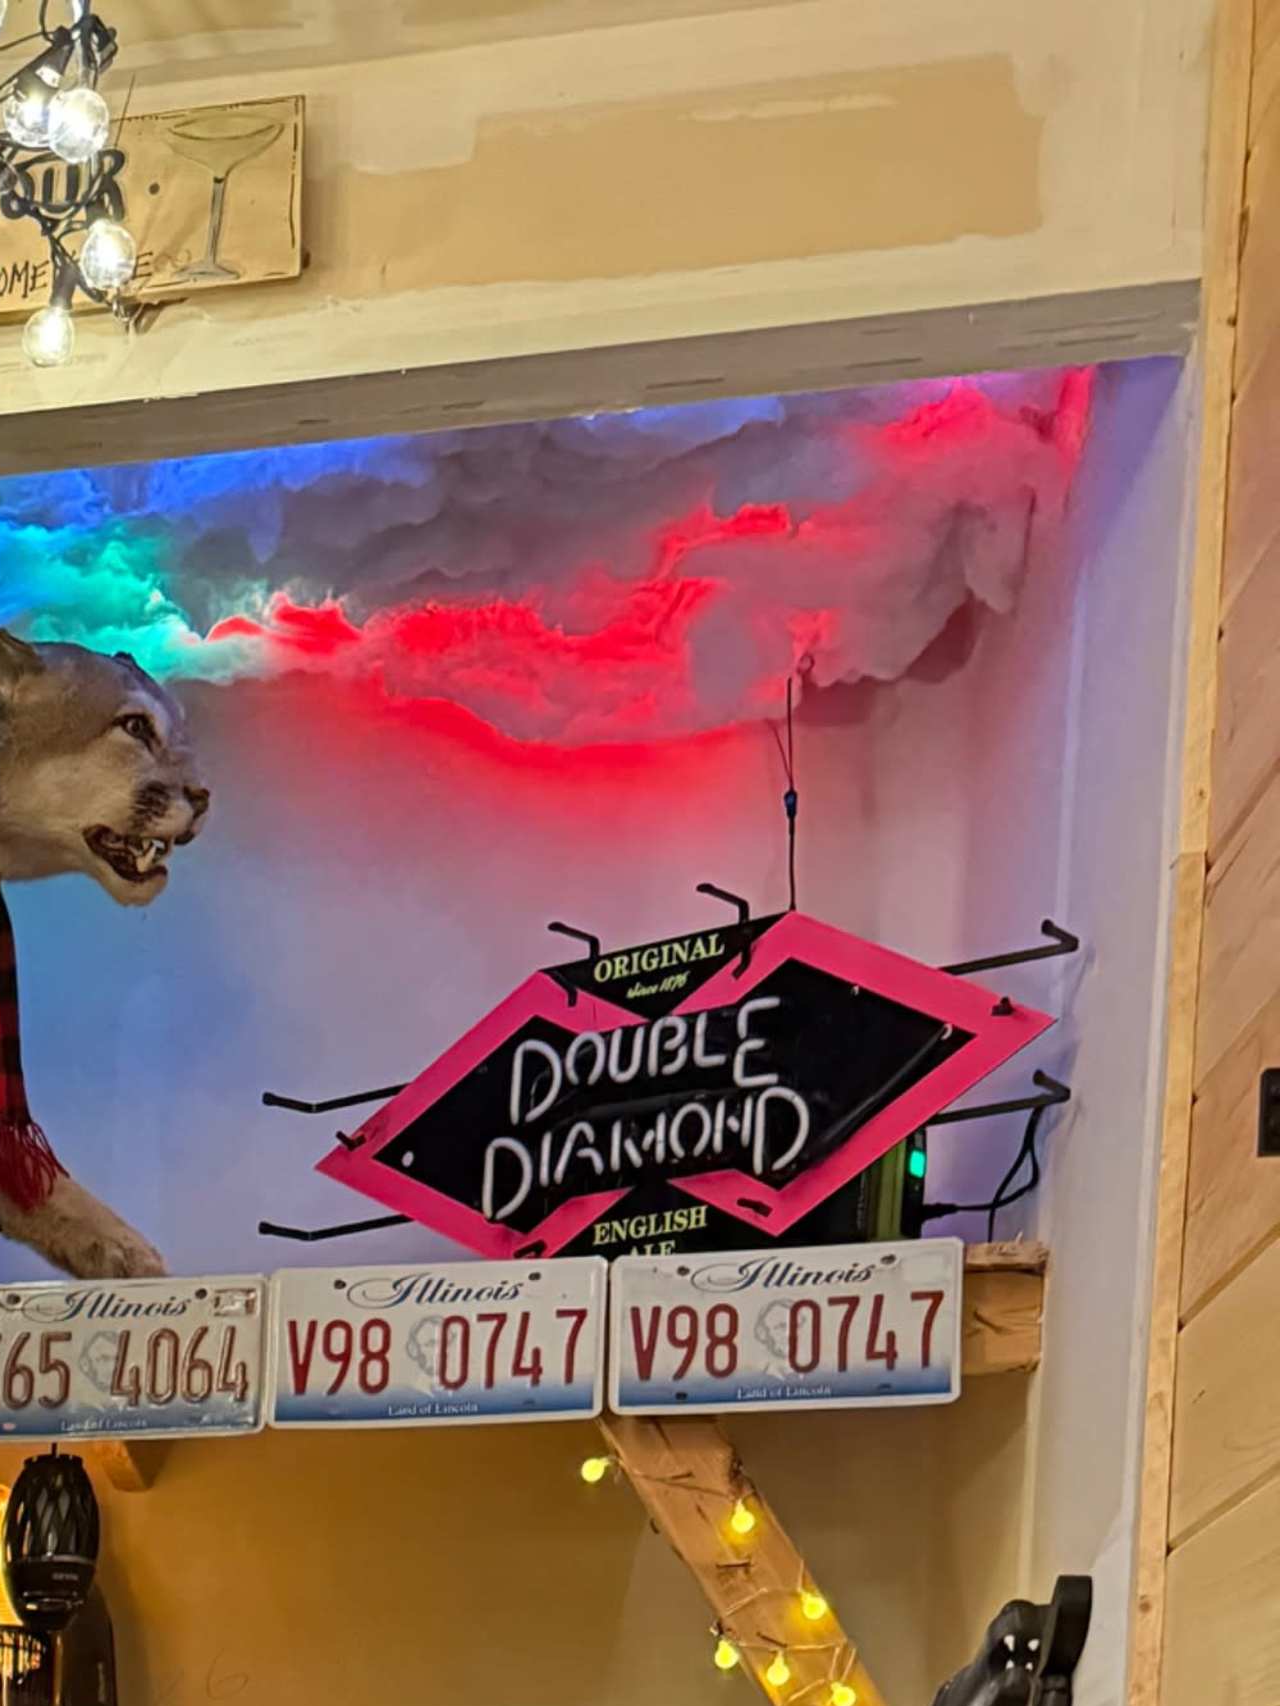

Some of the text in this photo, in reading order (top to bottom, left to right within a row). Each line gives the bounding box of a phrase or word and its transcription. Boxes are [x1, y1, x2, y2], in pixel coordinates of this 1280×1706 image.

[594, 934, 726, 984] ORIGINAL
[510, 997, 782, 1125] DOUBLE
[482, 1096, 810, 1221] DIAMOND
[592, 1205, 708, 1247] ENGLISH
[370, 1271, 525, 1309] Illinois
[720, 1254, 879, 1293] Illinois
[52, 1287, 192, 1322] Illinois
[287, 1307, 589, 1397] V98 0747
[630, 1289, 946, 1383] V98 0747
[110, 1325, 250, 1408] 4064
[388, 1402, 479, 1416] Land of Lincoln
